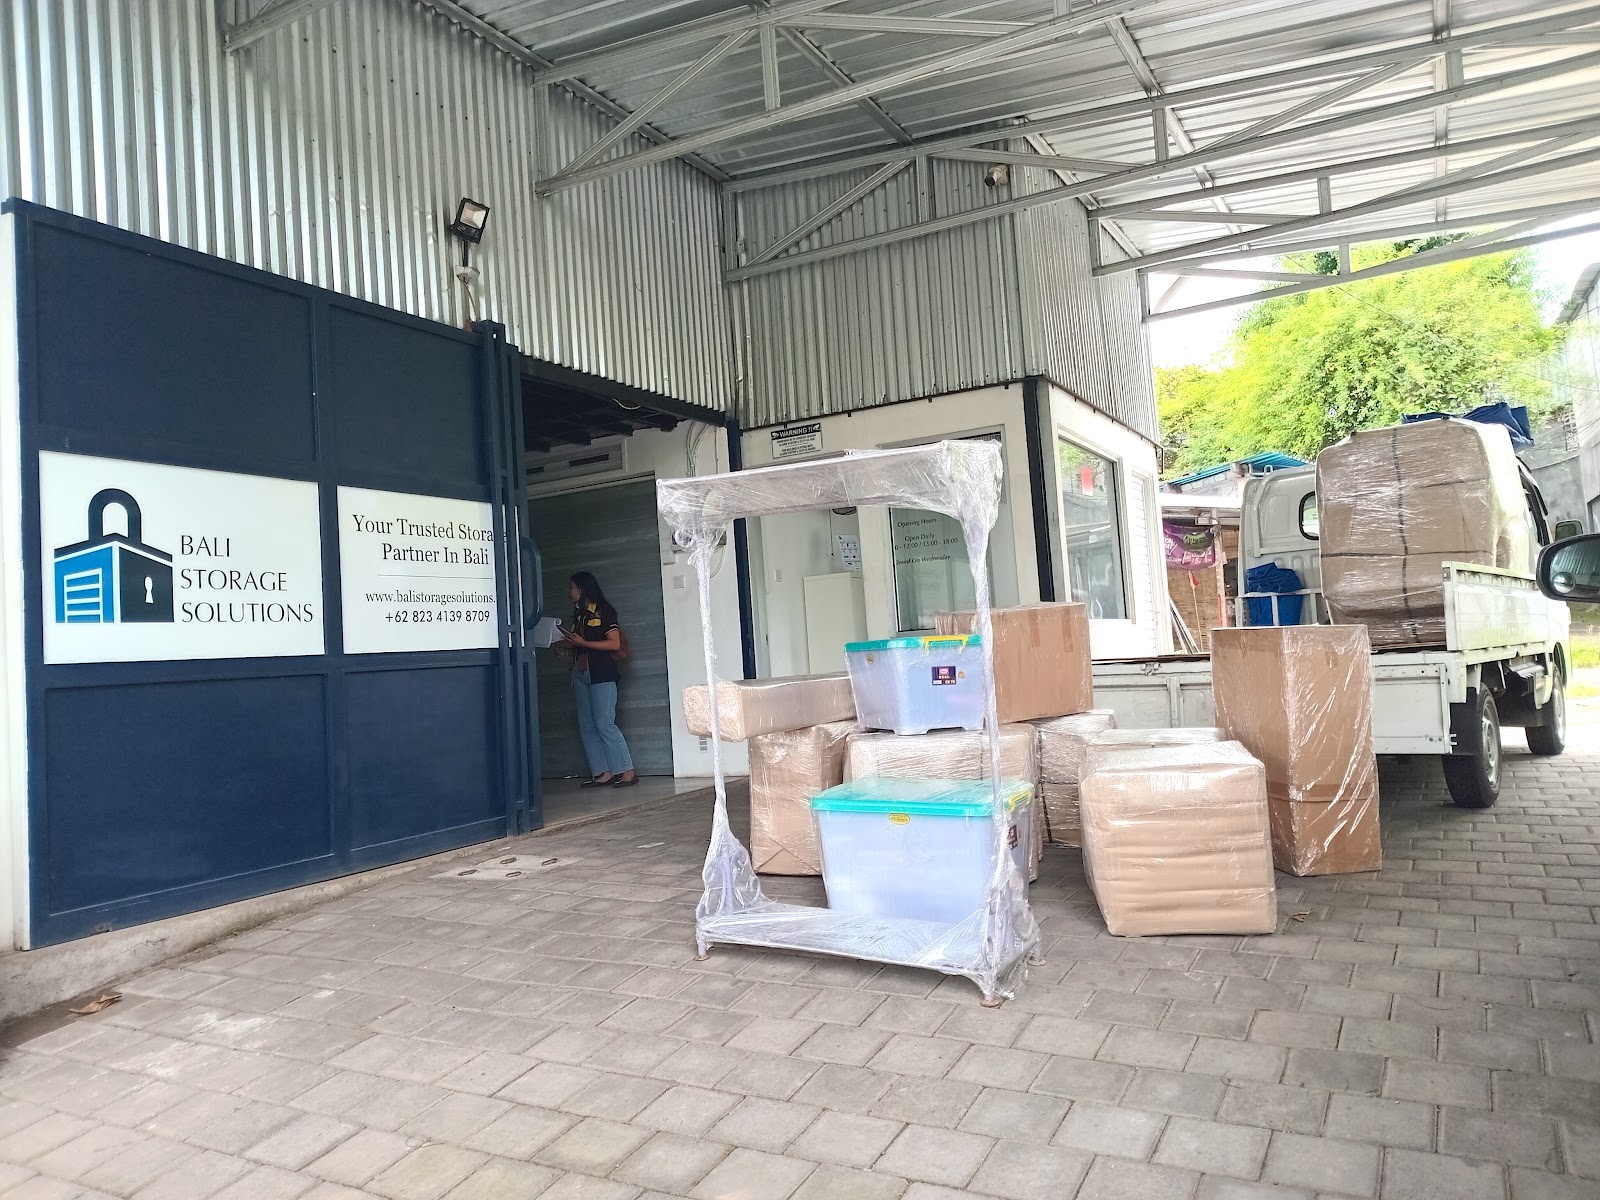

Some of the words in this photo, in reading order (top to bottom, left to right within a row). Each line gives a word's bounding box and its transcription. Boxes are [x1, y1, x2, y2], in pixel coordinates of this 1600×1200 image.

[779, 427, 808, 438] WARNING
[352, 514, 393, 535] Your
[396, 518, 455, 539] Trusted
[458, 523, 494, 542] Stora
[897, 520, 920, 529] Opening
[180, 535, 230, 557] BALI
[920, 532, 935, 540] Daily
[381, 543, 440, 563] Partner
[443, 546, 459, 564] In
[463, 547, 490, 566] Bali
[180, 568, 288, 591] STORAGE
[181, 602, 314, 623] SOLUTIONS
[385, 610, 409, 623] +62
[412, 610, 433, 623] 823
[436, 610, 462, 623] 4139
[465, 610, 490, 622] 8709
